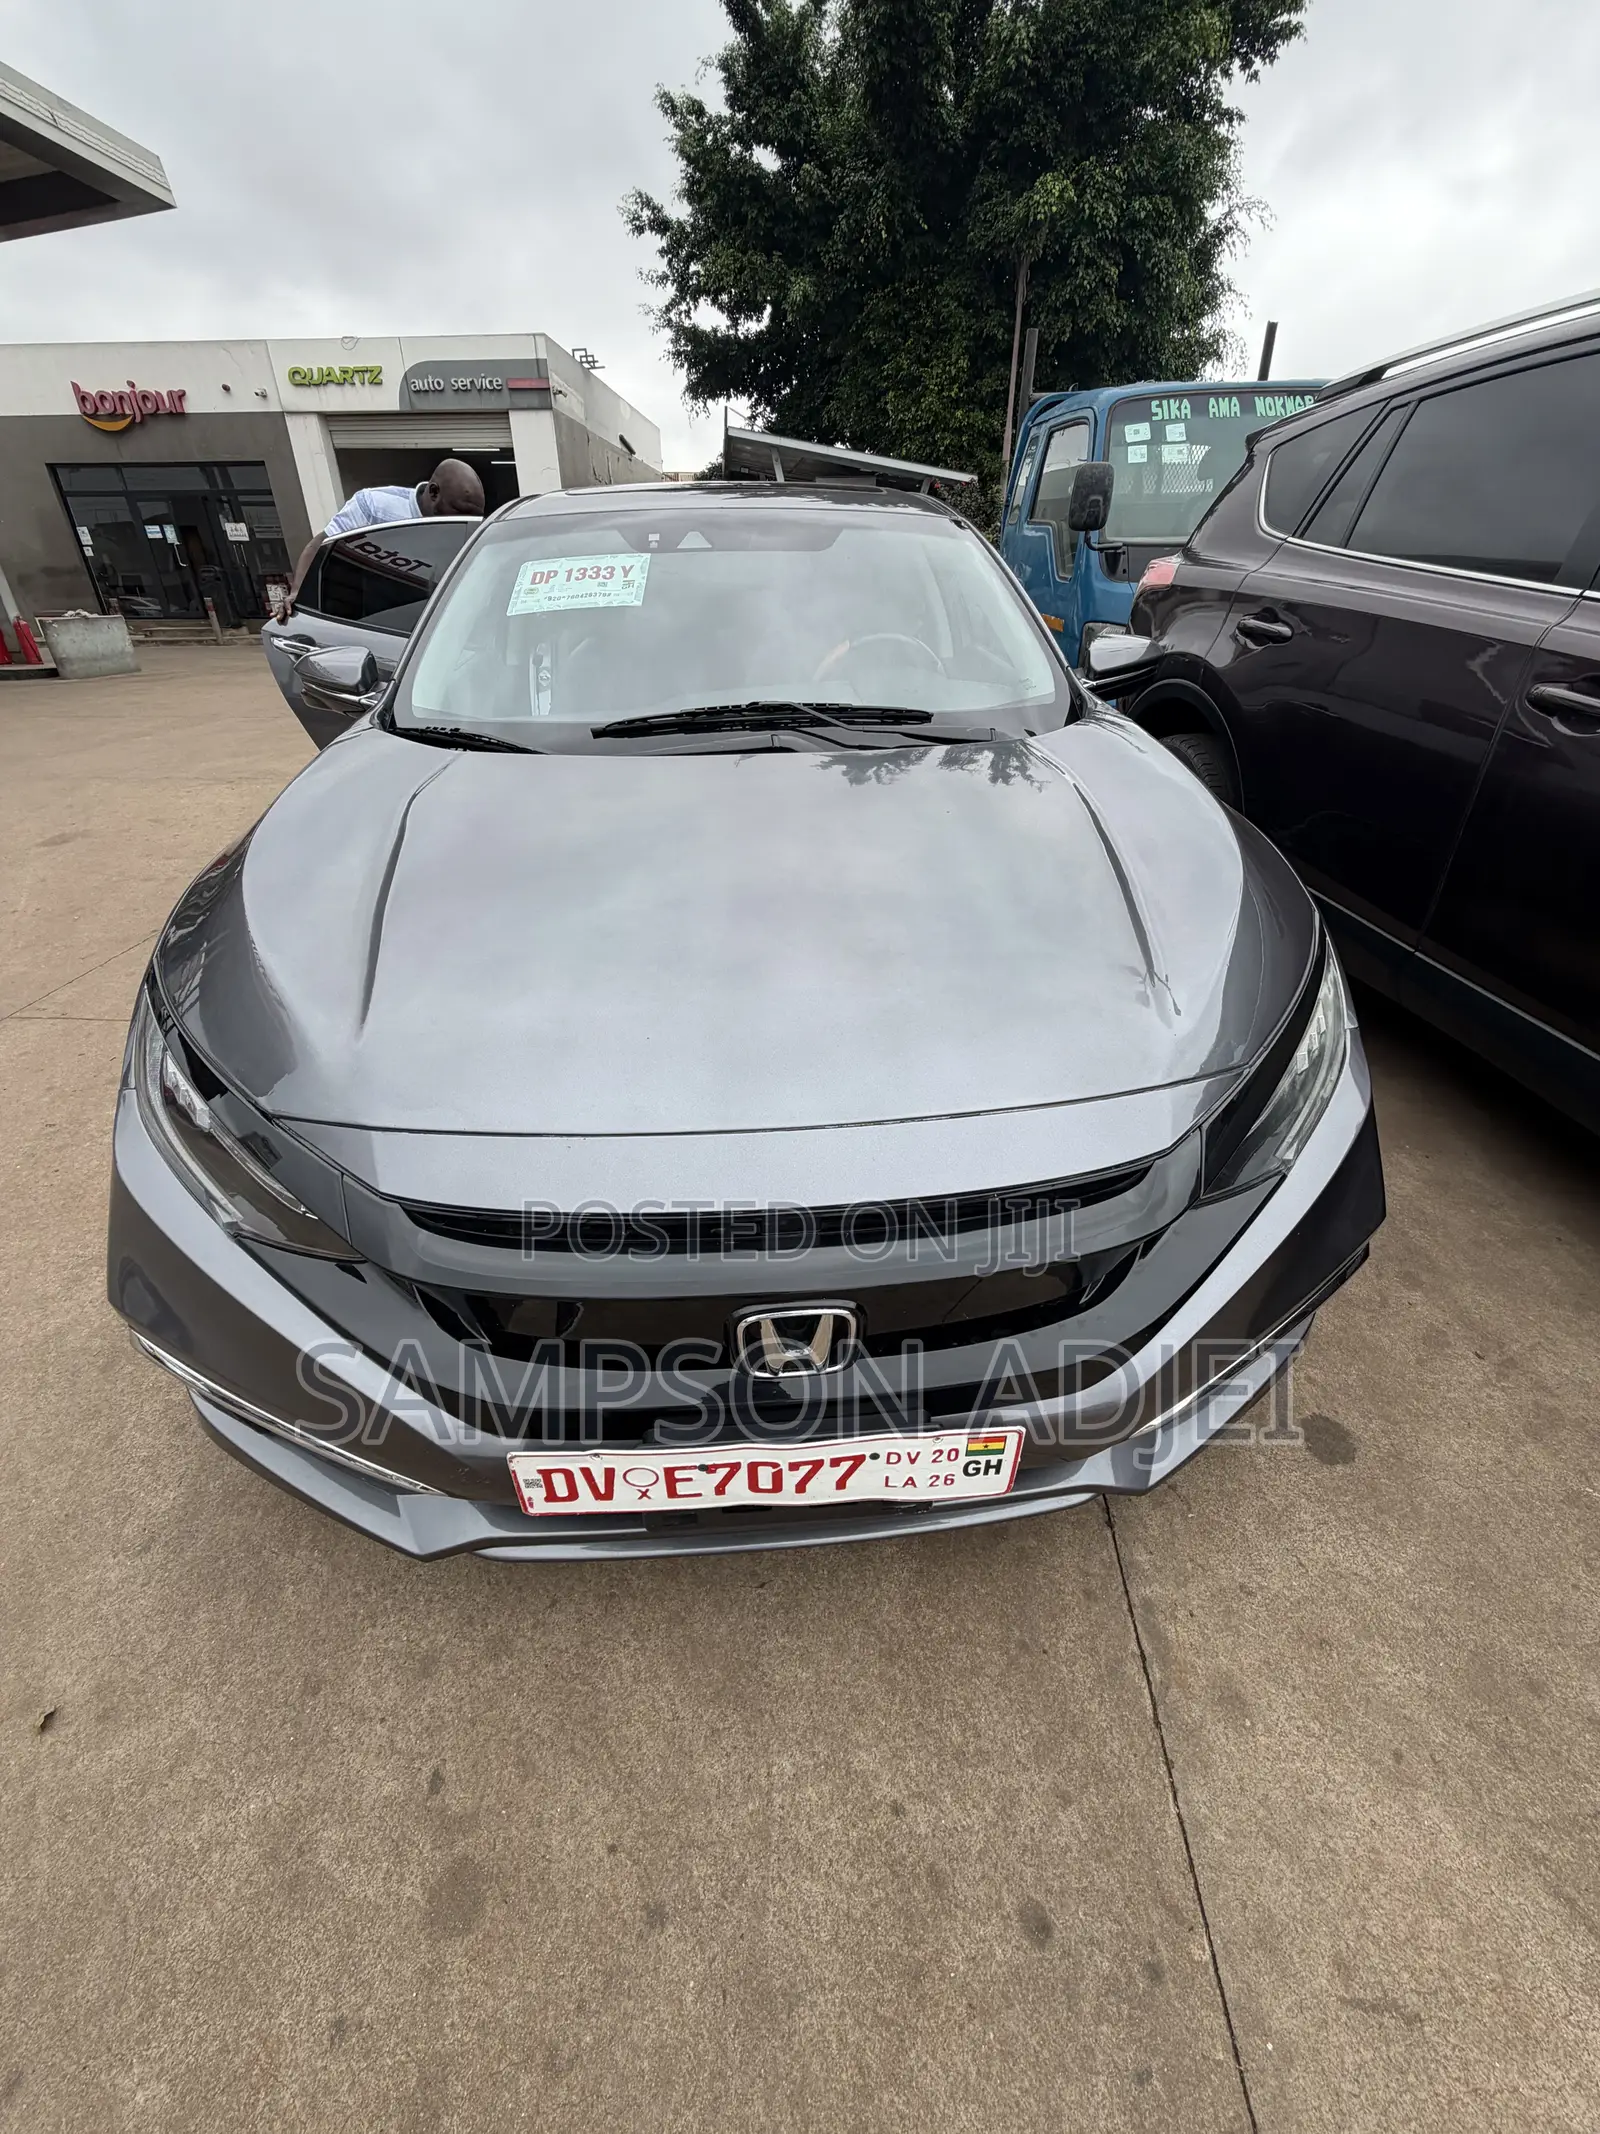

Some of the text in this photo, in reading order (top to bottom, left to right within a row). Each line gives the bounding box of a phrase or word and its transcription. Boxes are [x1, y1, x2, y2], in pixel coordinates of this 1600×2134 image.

[287, 366, 383, 387] QUARTZ
[410, 373, 503, 393] auto service
[70, 380, 187, 424] bonjour
[1151, 399, 1191, 421] SIKA
[1208, 396, 1241, 418] AMA
[530, 564, 635, 586] DP 1333 Y
[886, 1448, 960, 1465] DV 20
[536, 1466, 616, 1503] DV
[663, 1453, 867, 1499] E7077
[962, 1458, 1003, 1477] GH
[884, 1473, 956, 1488] LA 26
